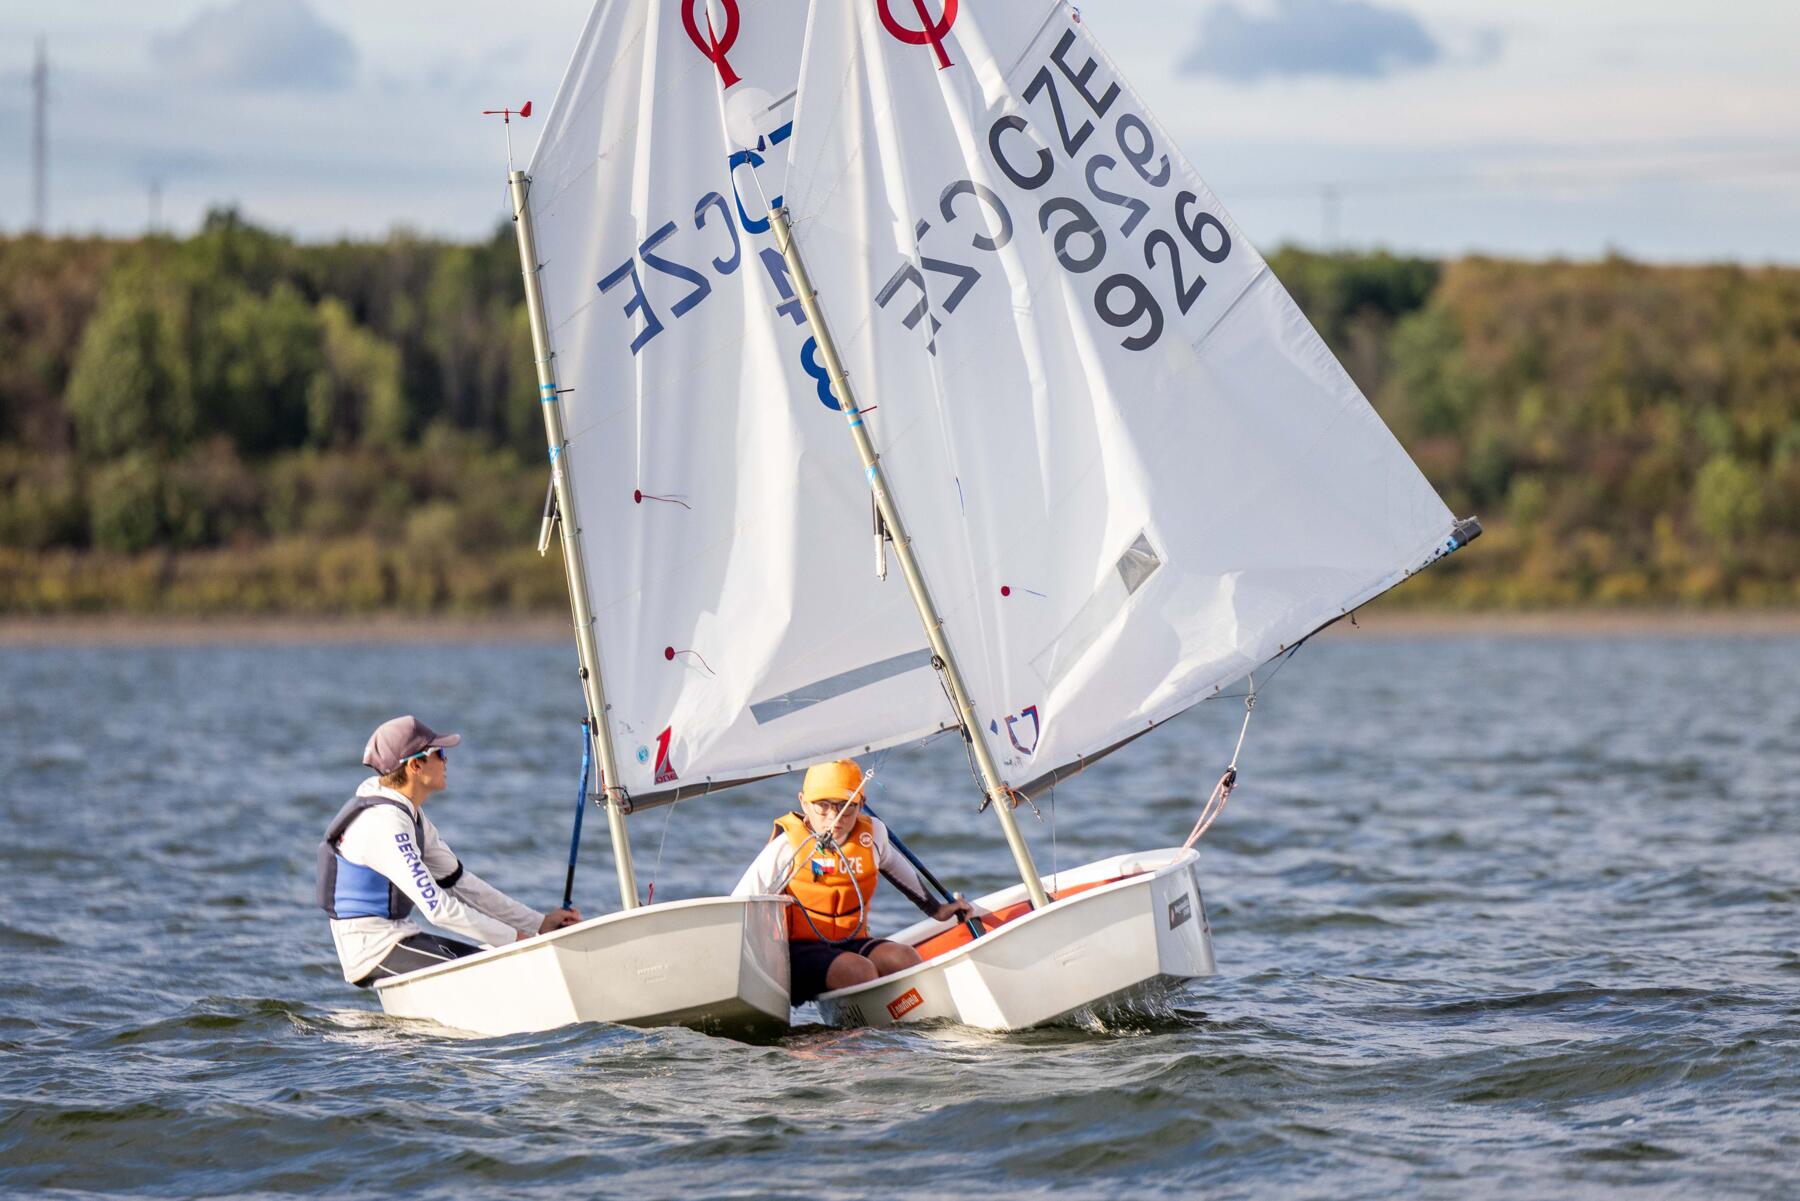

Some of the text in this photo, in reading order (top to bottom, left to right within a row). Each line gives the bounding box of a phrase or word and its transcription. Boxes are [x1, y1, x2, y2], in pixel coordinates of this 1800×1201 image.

[989, 28, 1121, 190] CZE
[1094, 191, 1232, 351] 926
[395, 832, 438, 911] BERMUDA
[839, 856, 863, 874] CZE
